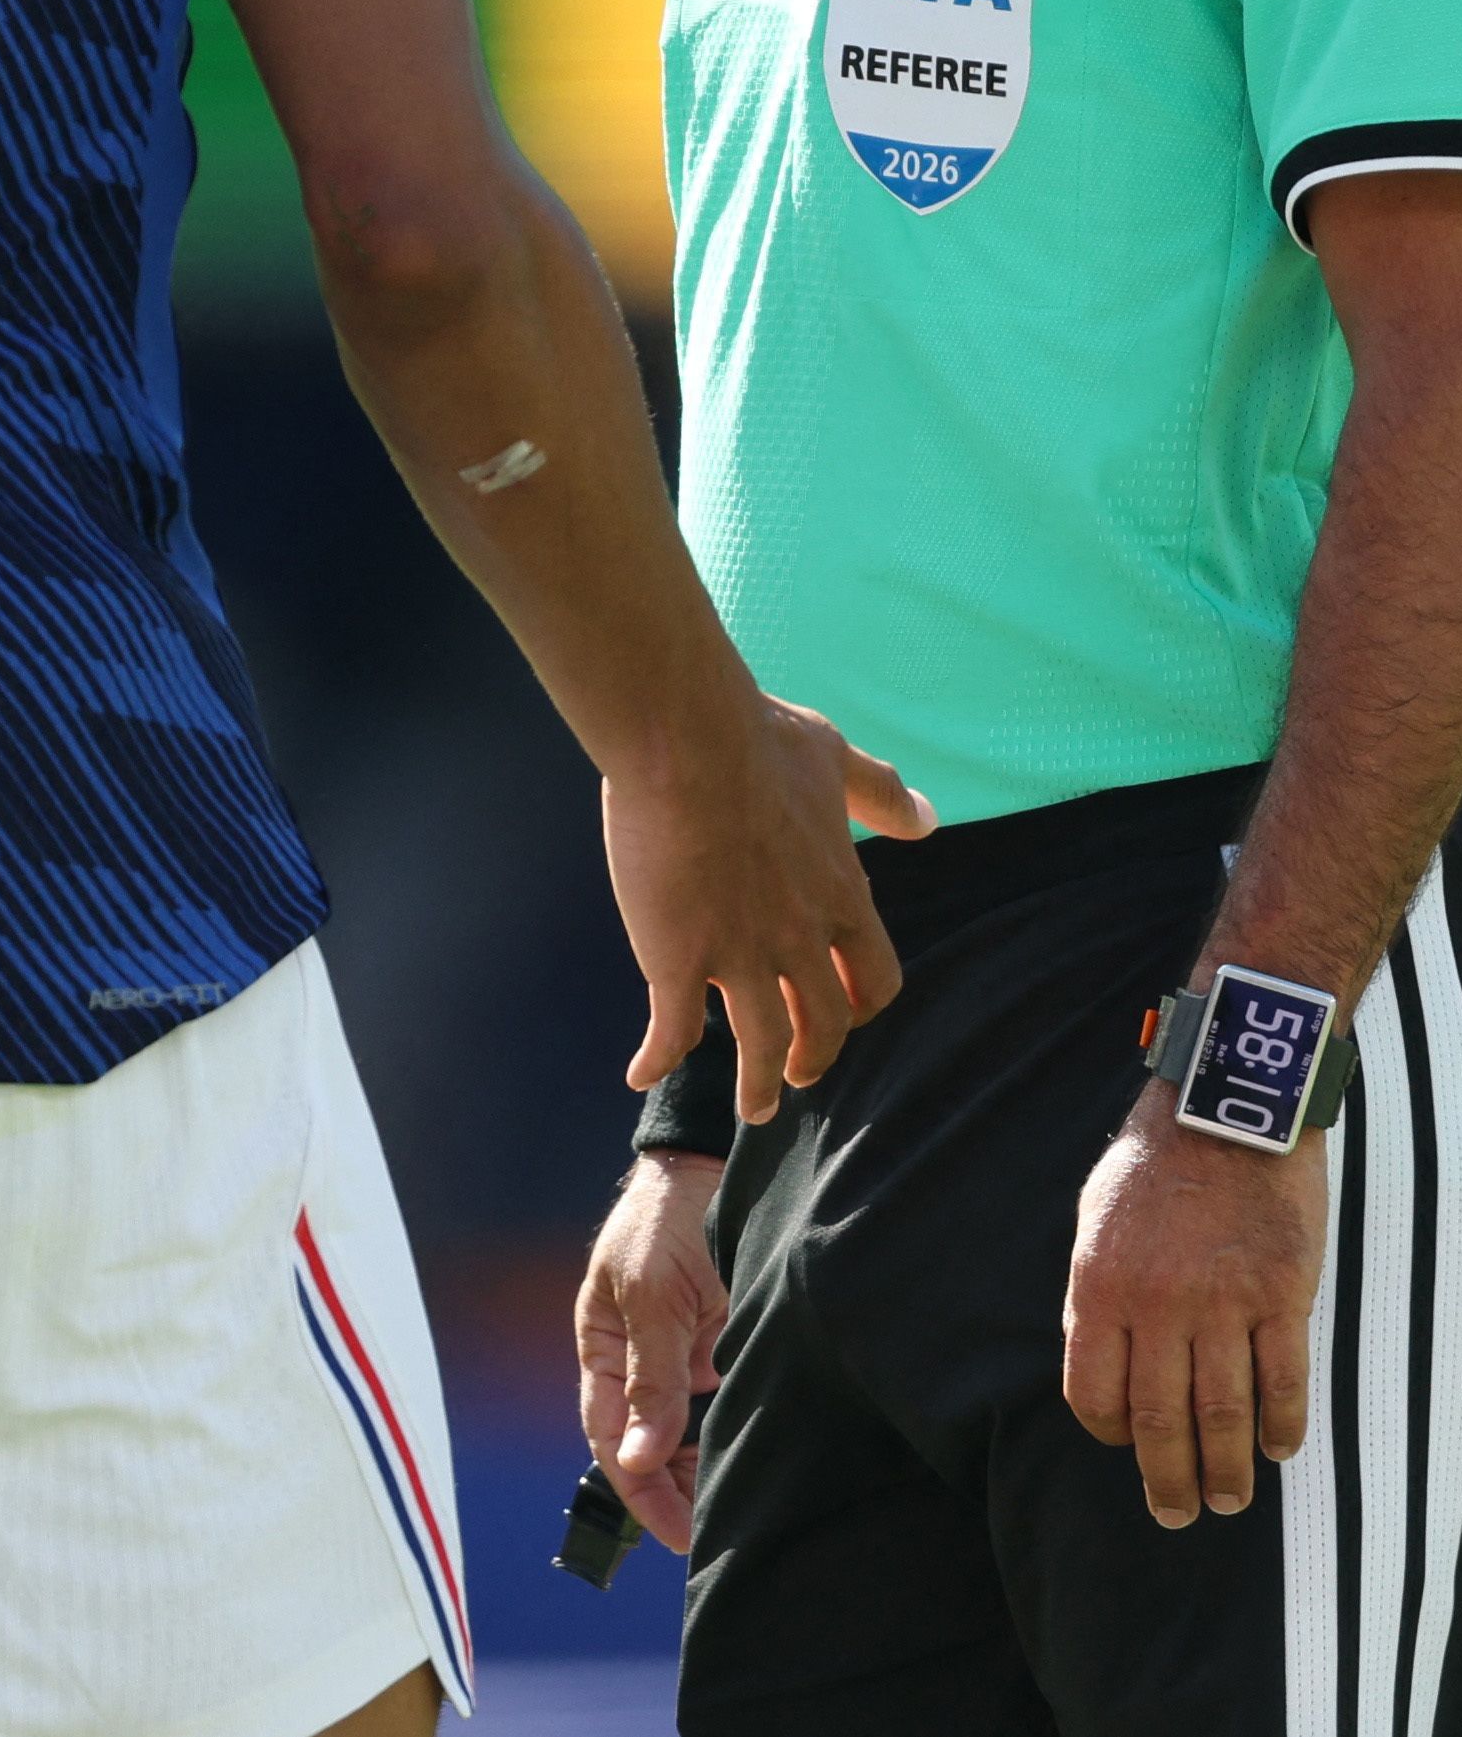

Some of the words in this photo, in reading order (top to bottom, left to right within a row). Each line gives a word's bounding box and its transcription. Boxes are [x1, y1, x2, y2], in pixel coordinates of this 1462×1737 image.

[840, 45, 1008, 98] REFEREE
[881, 148, 960, 185] 2026
[89, 982, 226, 1010] AERO-FIT
[1216, 1000, 1304, 1134] 58:10
